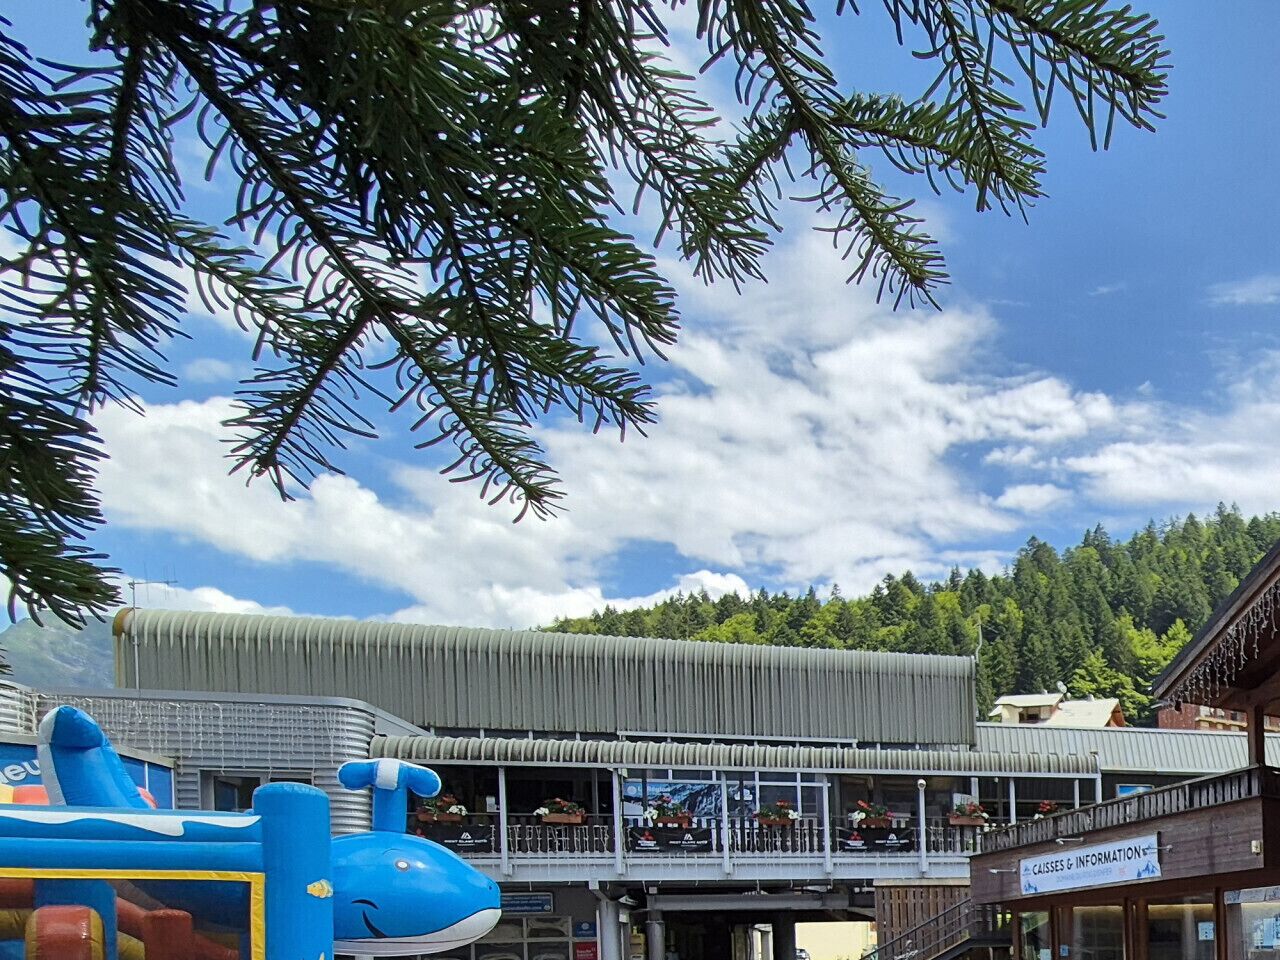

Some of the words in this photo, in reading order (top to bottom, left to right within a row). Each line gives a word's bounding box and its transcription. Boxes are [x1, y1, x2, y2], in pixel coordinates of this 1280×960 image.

[1032, 857, 1065, 876] CAISSES
[1067, 858, 1073, 870] &
[1076, 845, 1142, 869] INFORMATION
